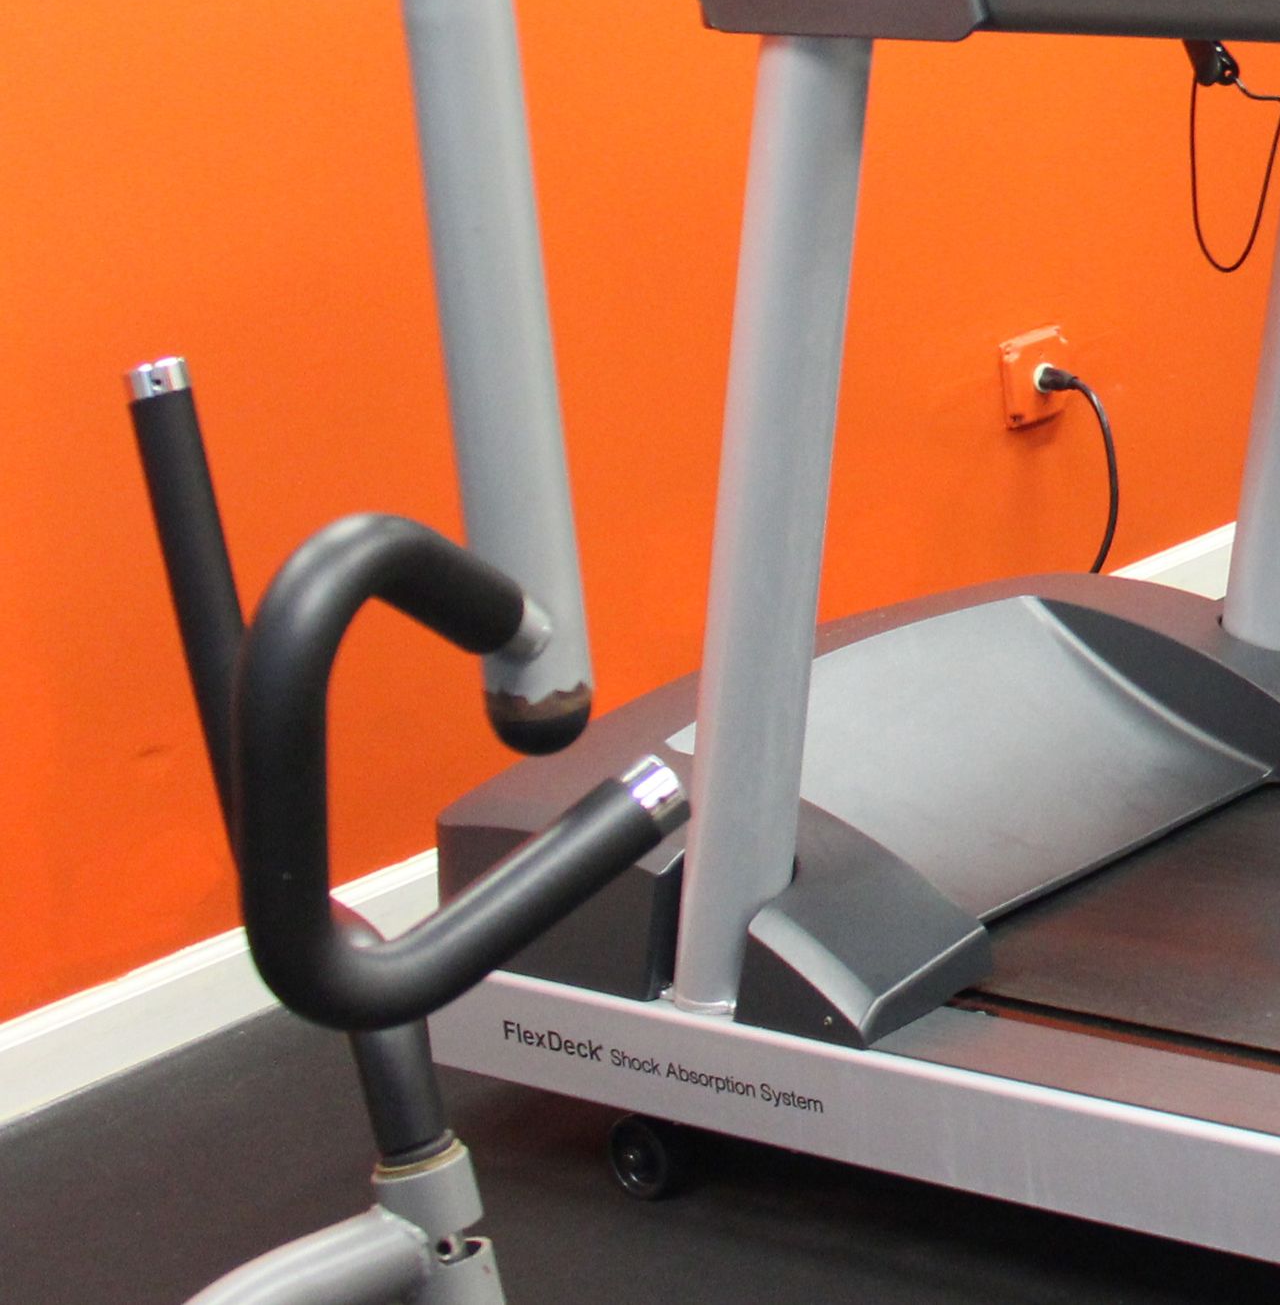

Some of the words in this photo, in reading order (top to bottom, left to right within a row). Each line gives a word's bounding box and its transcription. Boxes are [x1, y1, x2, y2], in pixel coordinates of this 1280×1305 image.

[503, 1020, 603, 1062] FlexDeck
[610, 1048, 661, 1077] Shock
[666, 1061, 756, 1099] Absorption
[760, 1083, 824, 1114] System
